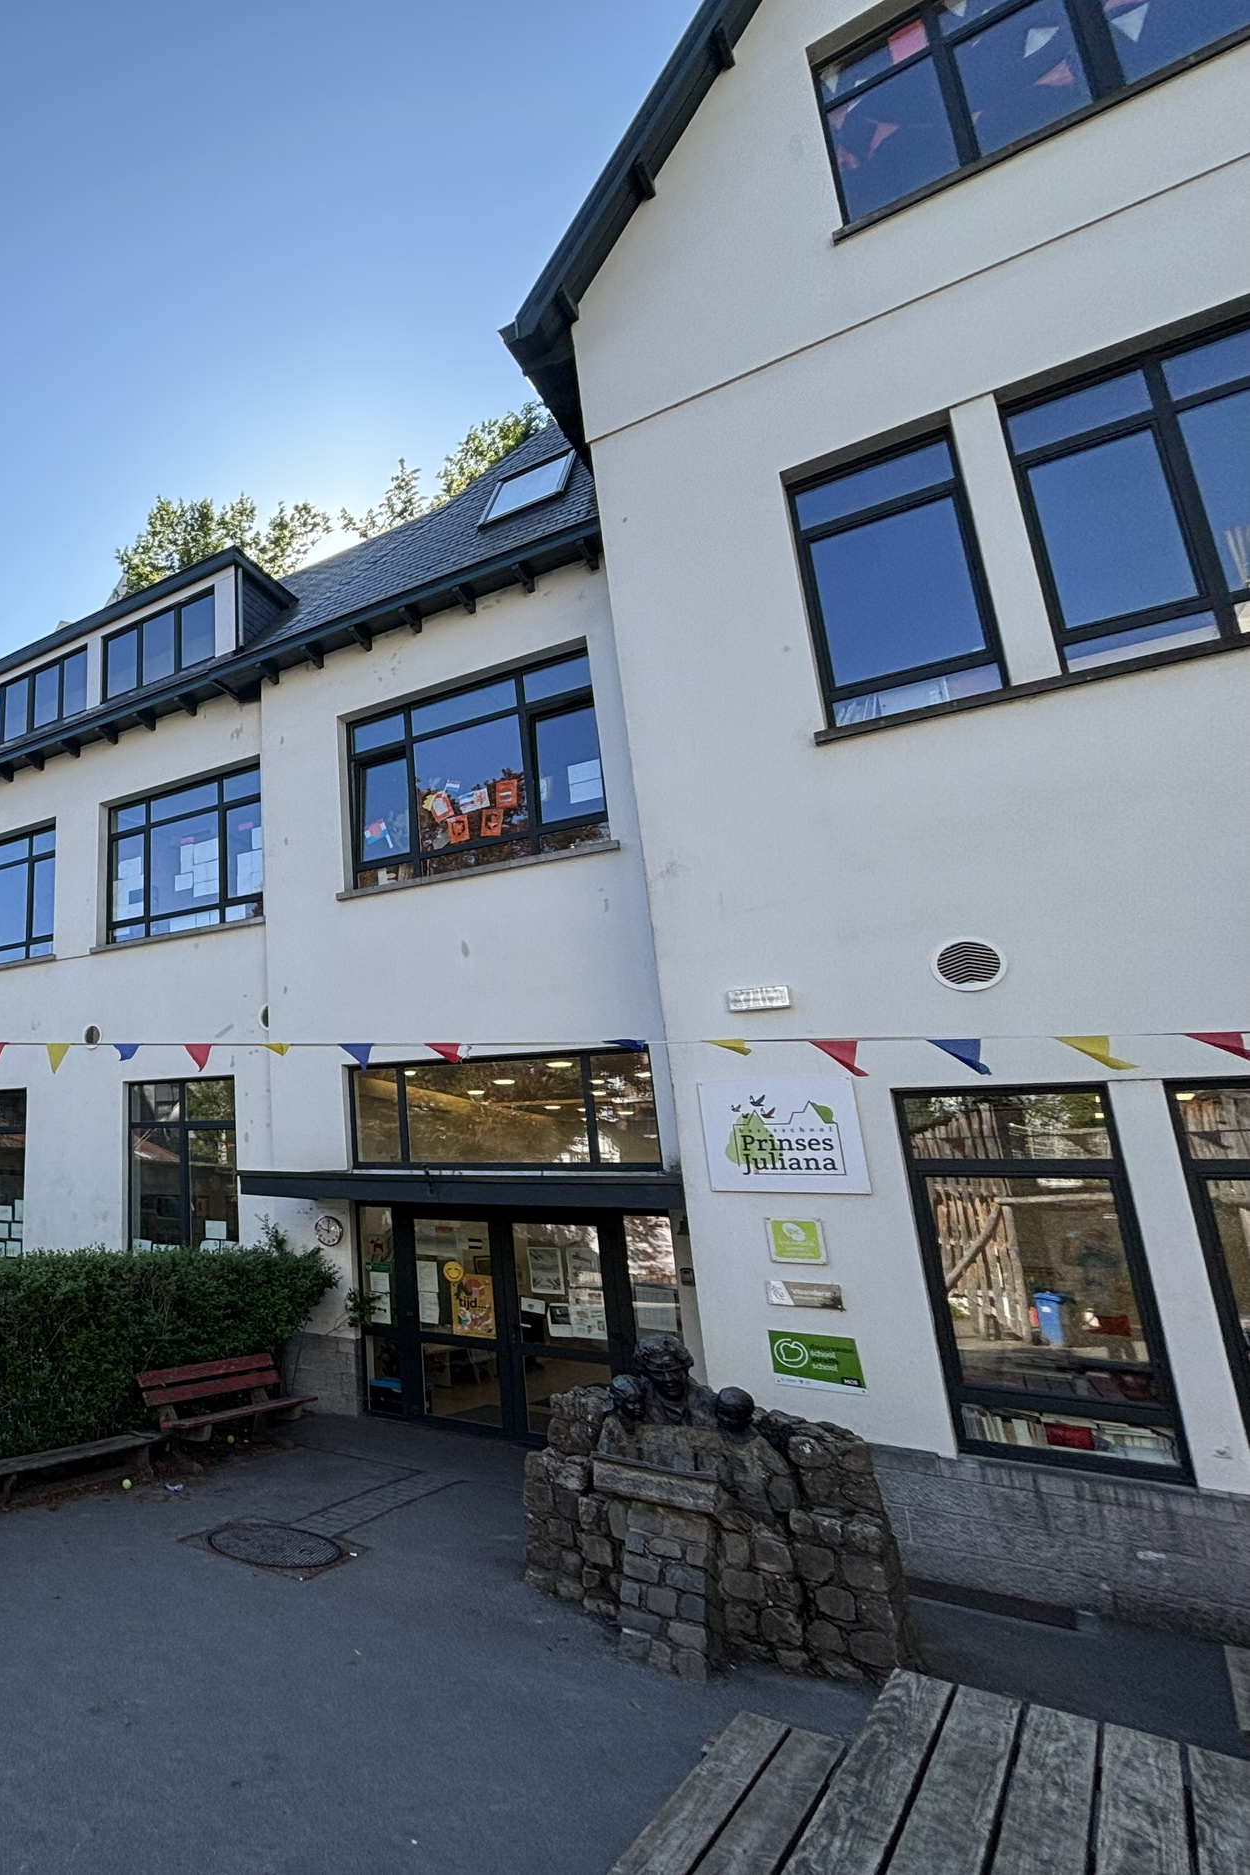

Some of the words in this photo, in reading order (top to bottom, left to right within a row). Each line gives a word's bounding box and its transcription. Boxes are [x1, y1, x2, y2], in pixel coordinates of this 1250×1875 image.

[741, 1134, 834, 1151] Prinses
[742, 1152, 838, 1175] Juliana
[810, 1350, 836, 1359] school
[811, 1363, 838, 1372] school
